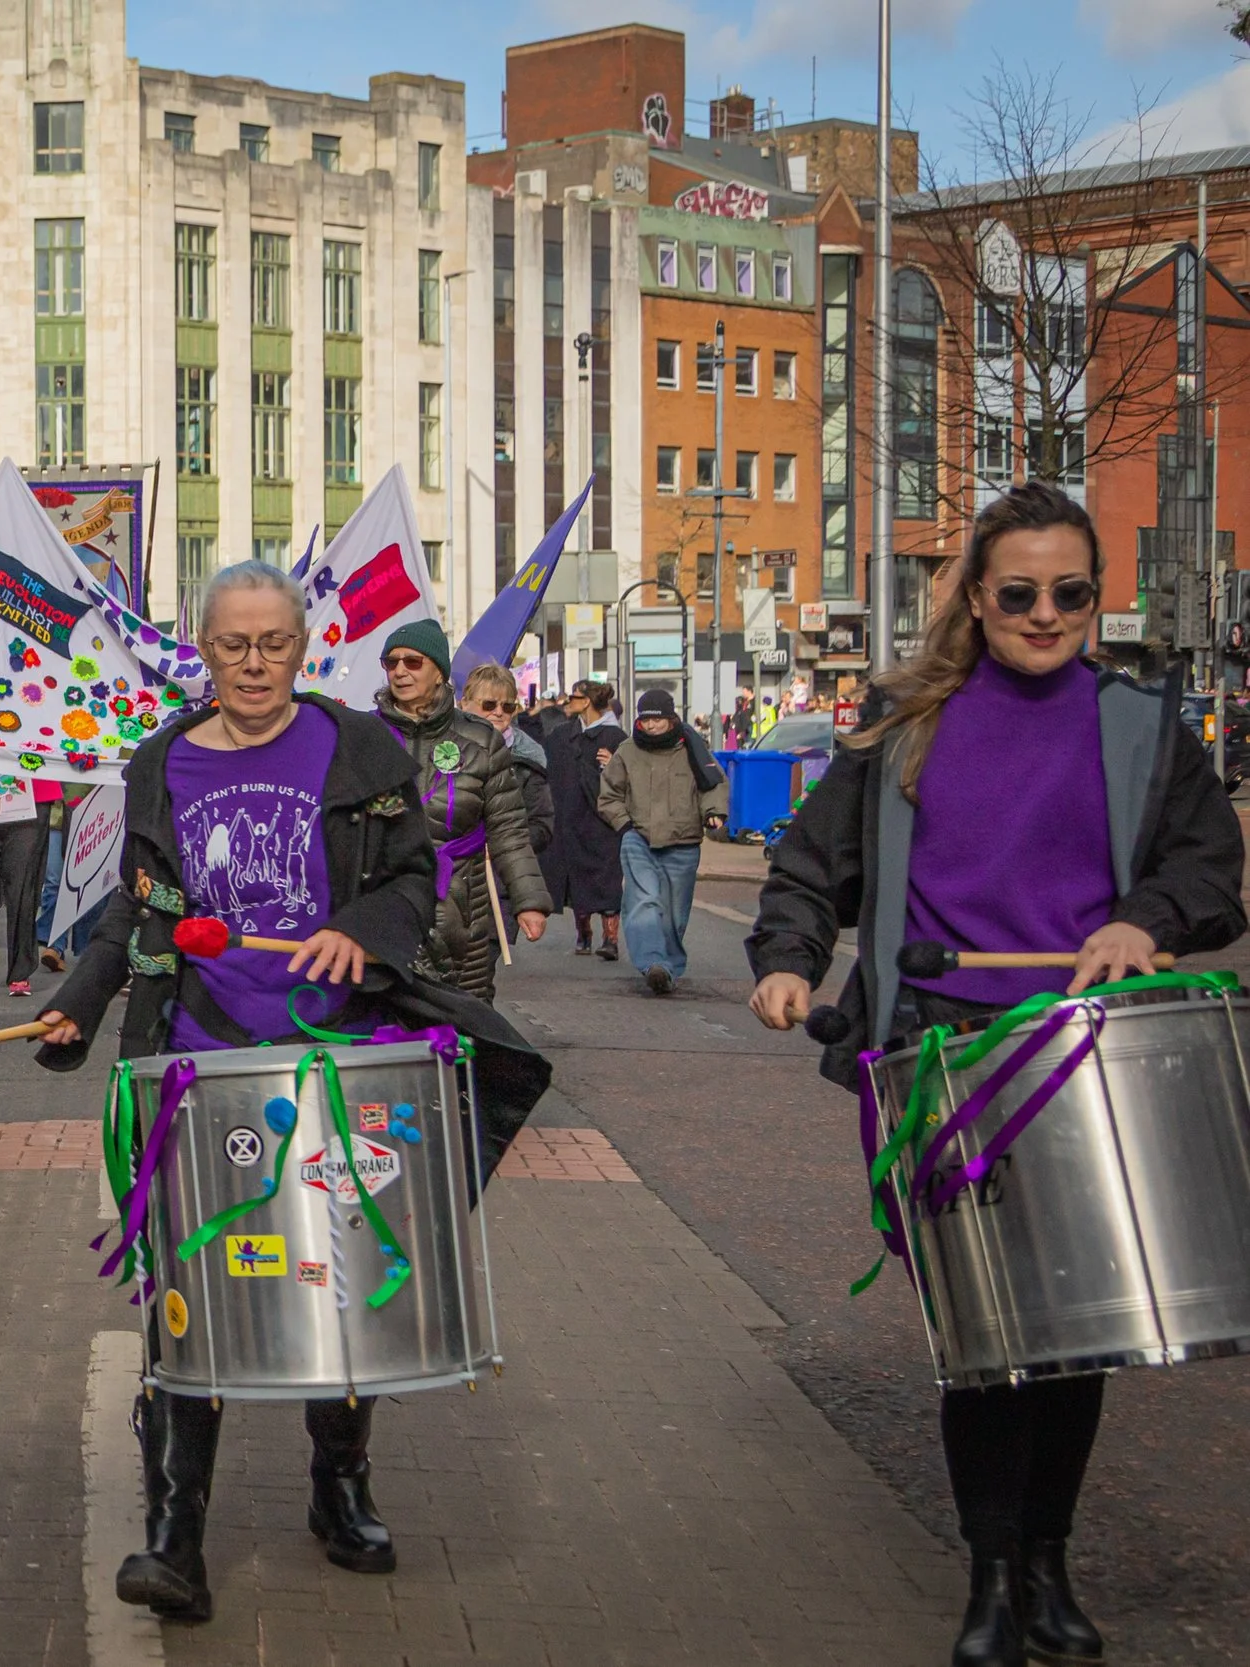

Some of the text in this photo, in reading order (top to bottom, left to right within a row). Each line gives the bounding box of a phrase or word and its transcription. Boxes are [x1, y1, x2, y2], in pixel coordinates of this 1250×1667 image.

[22, 572, 45, 597] THE
[25, 605, 53, 631] NOT
[54, 623, 70, 642] BE
[759, 648, 788, 665] xtern
[179, 783, 317, 823] THEY CAN'T BURN US ALL
[73, 810, 120, 868] Matter!
[77, 811, 105, 848] Ma's
